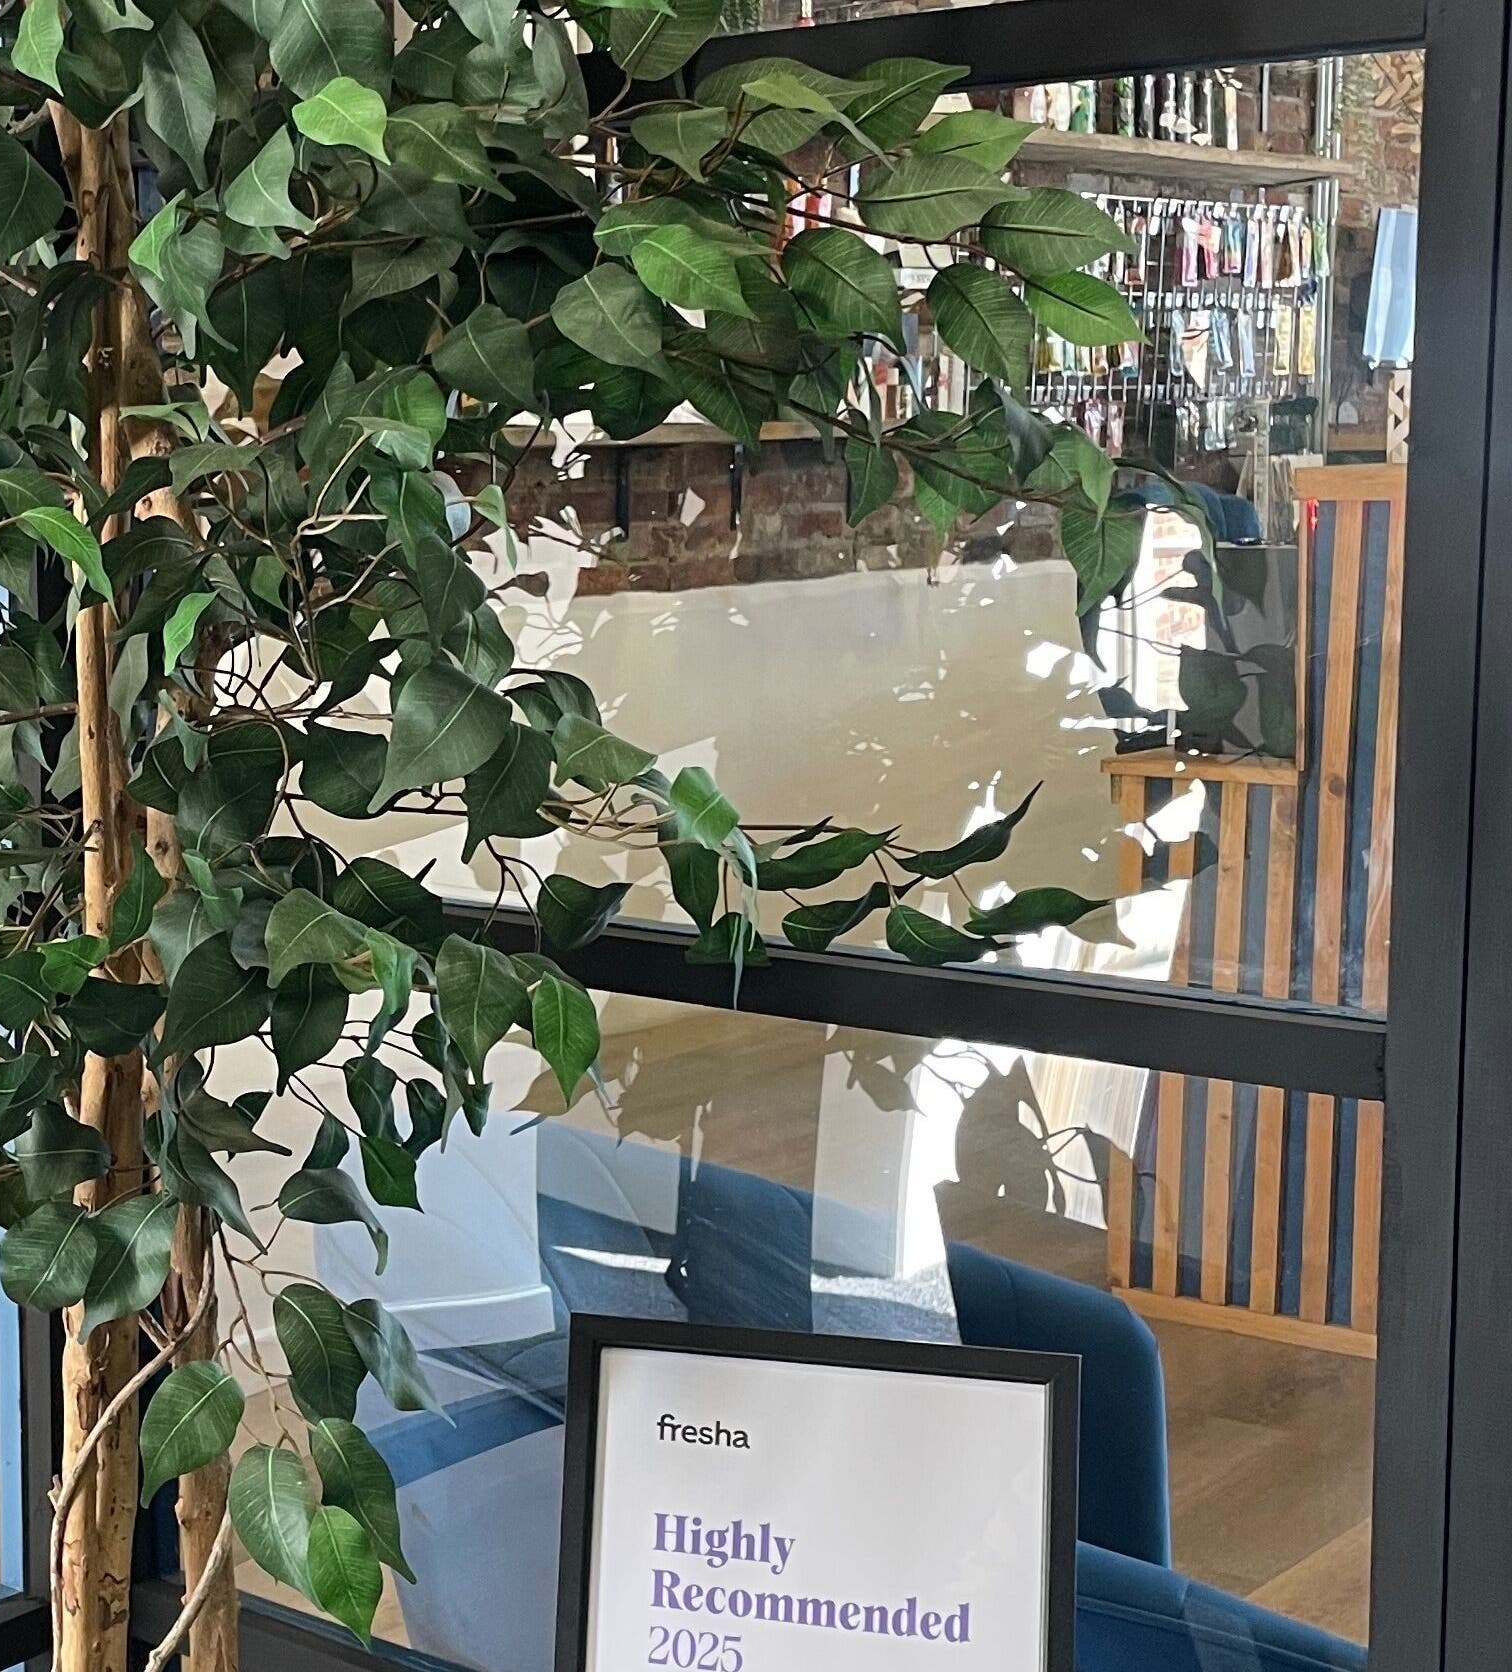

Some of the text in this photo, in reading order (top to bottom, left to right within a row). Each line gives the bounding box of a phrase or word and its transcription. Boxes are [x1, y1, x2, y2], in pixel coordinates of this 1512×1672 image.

[656, 1413, 751, 1449] fresha
[652, 1512, 797, 1576] Highly
[649, 1568, 971, 1644] Recommended
[647, 1625, 744, 1672] 2025
